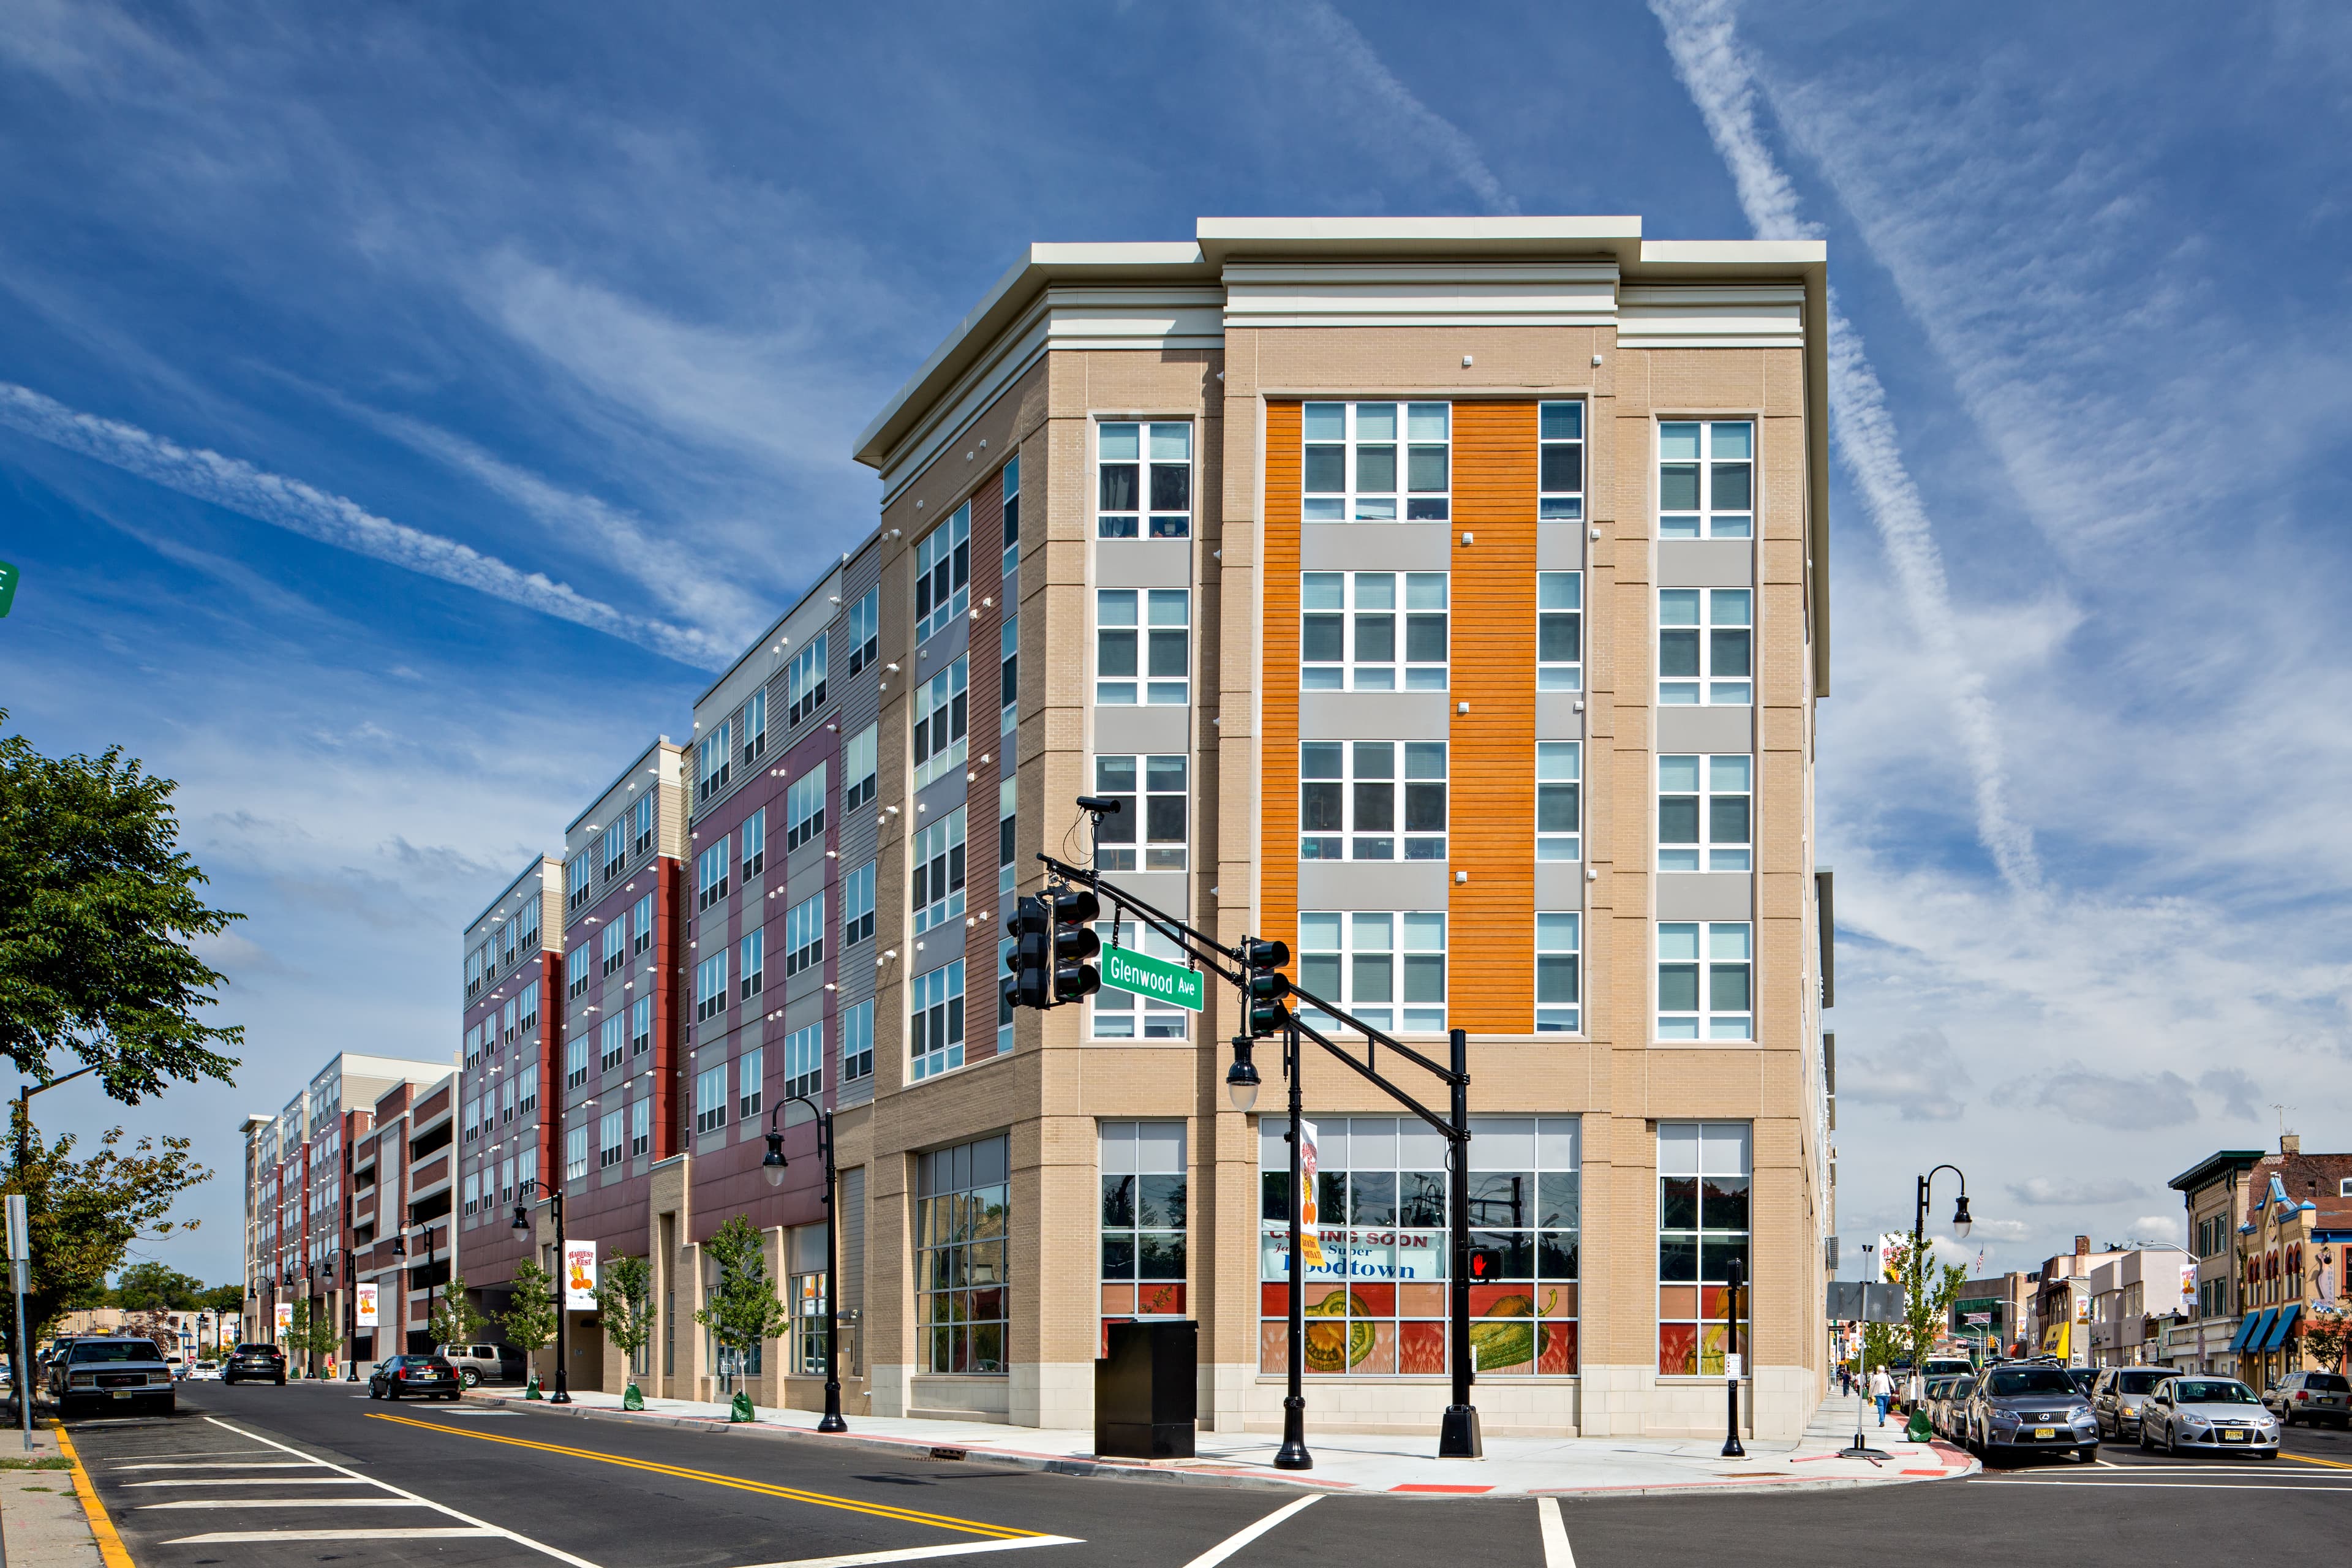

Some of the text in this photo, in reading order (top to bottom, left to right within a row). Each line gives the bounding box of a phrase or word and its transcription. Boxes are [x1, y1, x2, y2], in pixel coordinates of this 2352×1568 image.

[1110, 956, 1195, 996] Glenwood Ave
[1270, 1231, 1428, 1248] CING SOON
[568, 1251, 594, 1259] HARVEST
[1281, 1254, 1414, 1278] odtown
